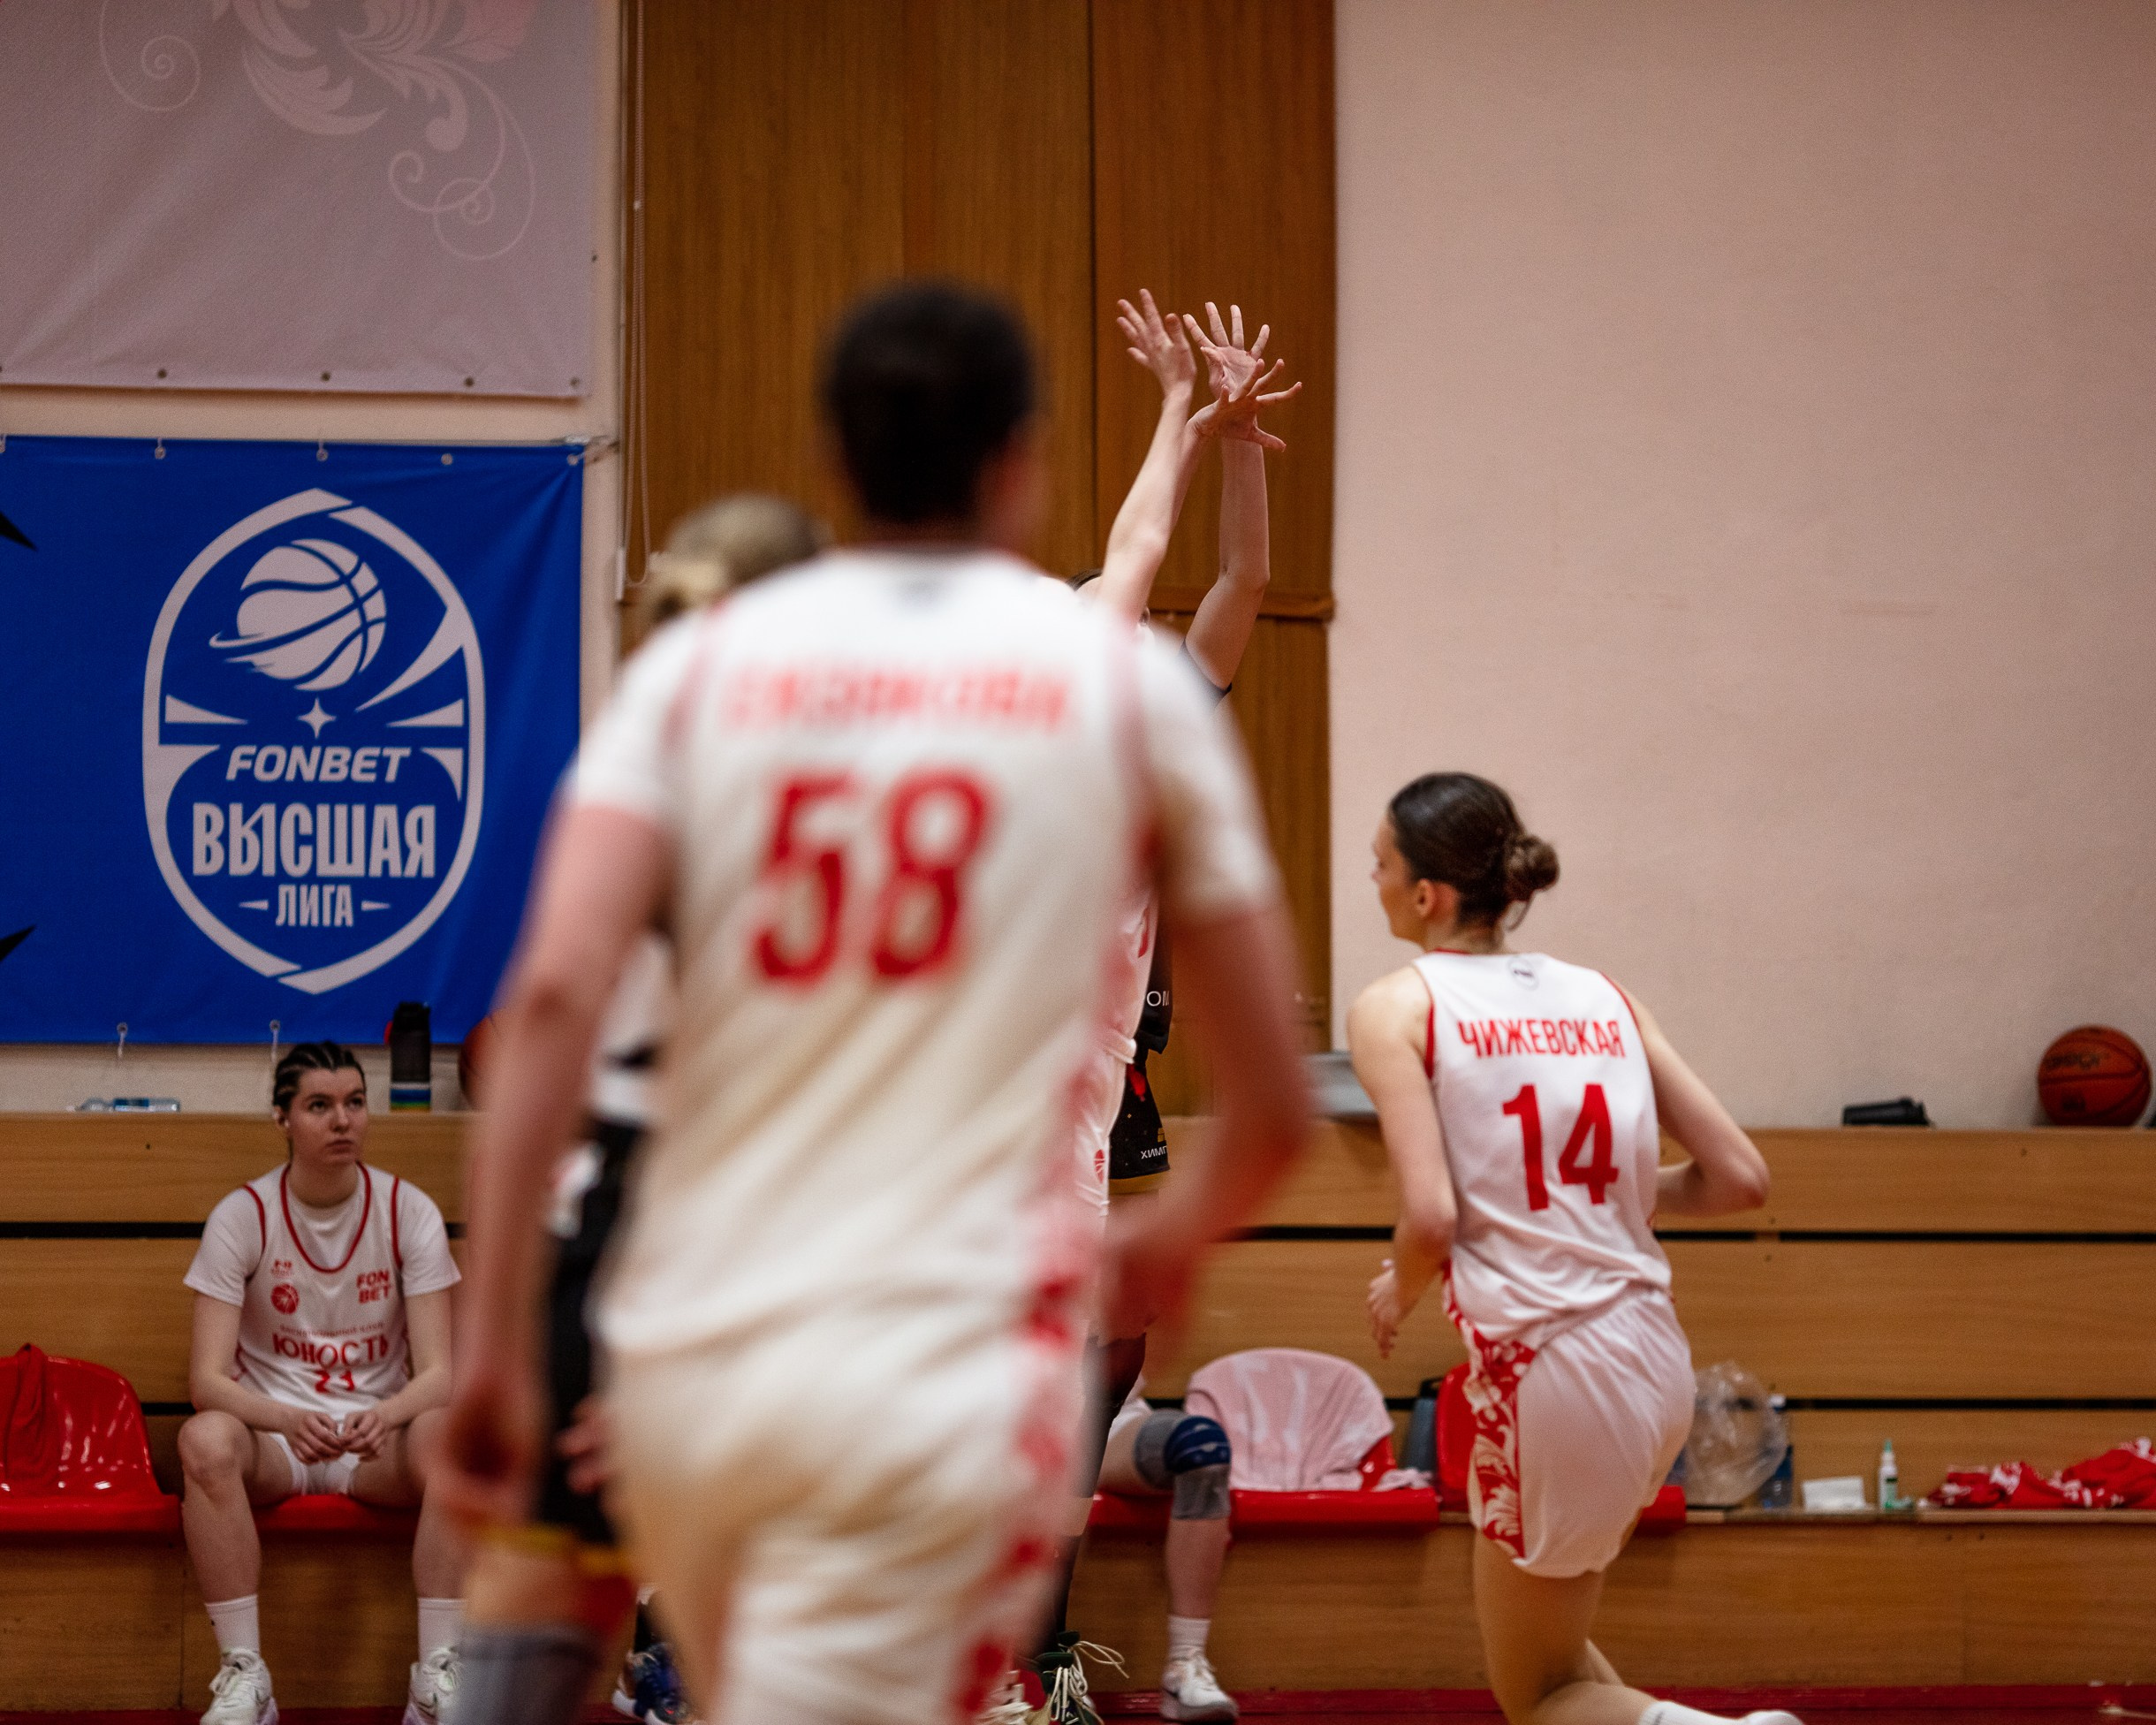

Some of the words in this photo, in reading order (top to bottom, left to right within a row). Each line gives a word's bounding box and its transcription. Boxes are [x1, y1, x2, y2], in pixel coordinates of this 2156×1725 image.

[225, 745, 412, 783] FONBET
[192, 802, 437, 878] ВЫСШАЯ
[748, 767, 998, 995] 58
[275, 884, 353, 928] ЛИГА
[1457, 1018, 1626, 1059] ЧИЖЕВСКАЯ
[1501, 1083, 1621, 1212] 14
[356, 1270, 390, 1289] FON
[358, 1284, 391, 1305] BET
[272, 1333, 389, 1369] ЮНОСТЬ
